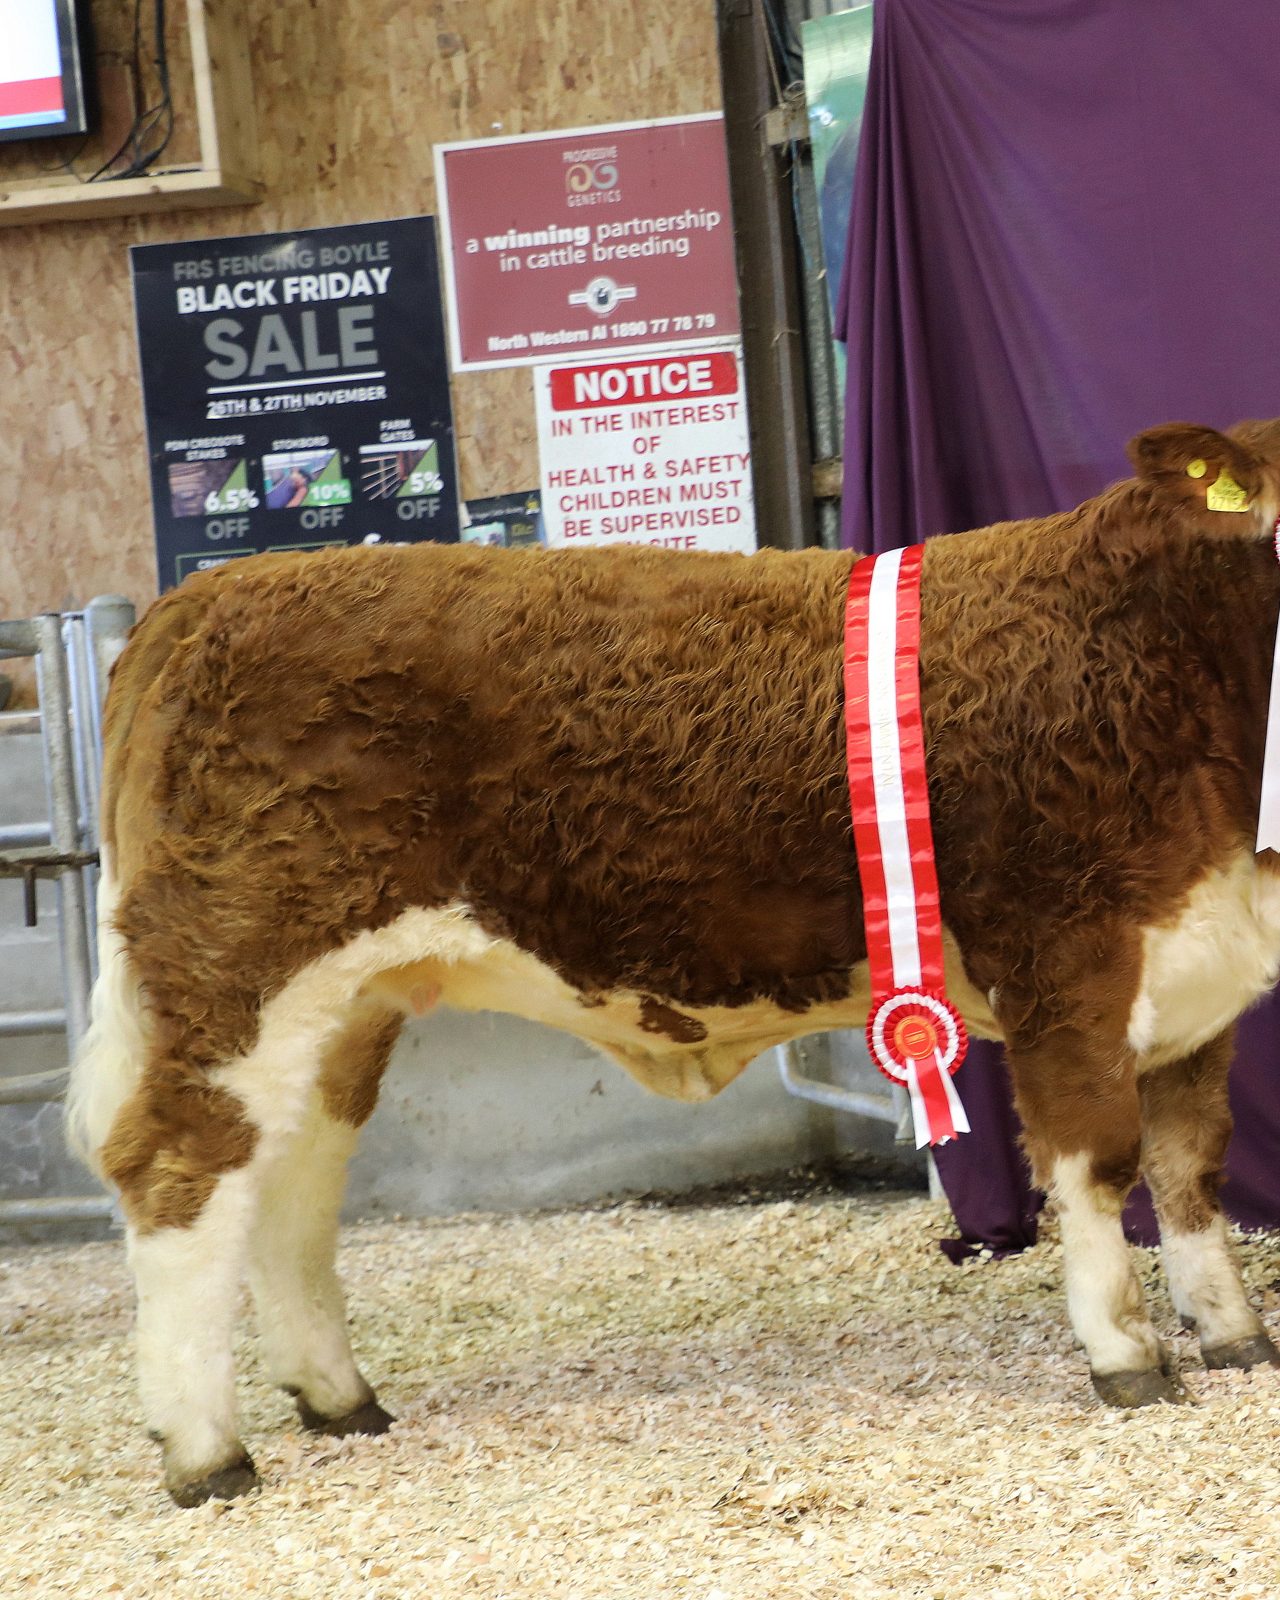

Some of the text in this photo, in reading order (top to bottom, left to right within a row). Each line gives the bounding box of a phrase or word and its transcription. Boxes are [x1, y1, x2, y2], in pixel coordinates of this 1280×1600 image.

[466, 208, 721, 253] a winning partnership
[173, 241, 390, 281] FRS FENCING BOYLE
[500, 236, 690, 272] in cattle breeding
[177, 267, 392, 314] BLACK FRIDAY
[203, 304, 378, 381] SALE
[488, 333, 528, 352] North
[531, 328, 589, 347] Western
[650, 318, 671, 334] 77
[696, 313, 716, 329] 79
[249, 398, 263, 412] &
[263, 394, 304, 411] 27TH
[304, 385, 387, 407] NOVEMBER
[574, 360, 713, 403] NOTICE
[551, 402, 740, 437] IN THE INTEREST
[632, 435, 661, 455] OF
[410, 471, 444, 493] 5%
[548, 452, 750, 489] HEALTH & SAFETY
[204, 487, 260, 512] 6.5%
[310, 483, 350, 500] 10%
[559, 479, 743, 513] CHILDREN MUST
[300, 507, 344, 530] OFF
[397, 497, 441, 521] OFF
[563, 518, 592, 539] BE
[600, 506, 741, 535] SUPERVISED
[205, 518, 250, 541] OFF
